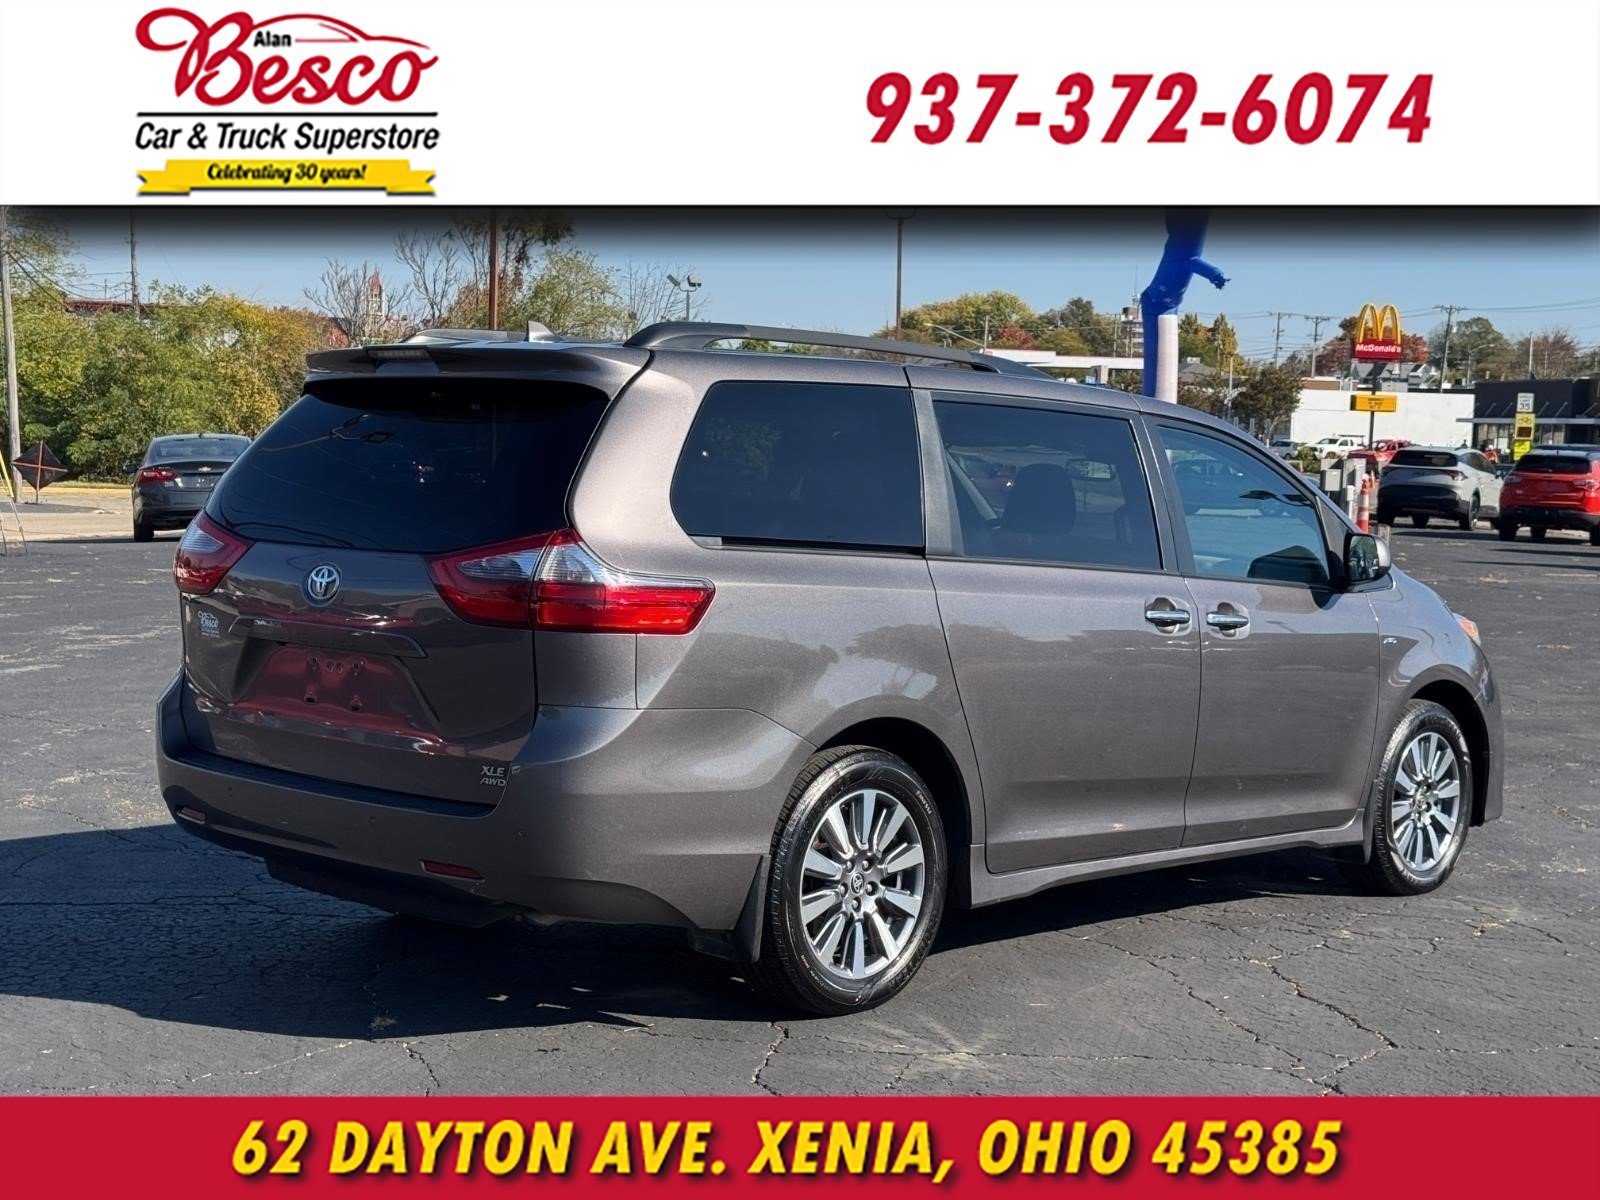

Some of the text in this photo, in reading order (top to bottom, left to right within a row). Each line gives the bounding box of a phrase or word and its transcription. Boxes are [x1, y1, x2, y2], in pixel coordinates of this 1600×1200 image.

[1355, 343, 1402, 353] McDonald's
[481, 765, 505, 777] XLE
[480, 777, 506, 787] AWD
